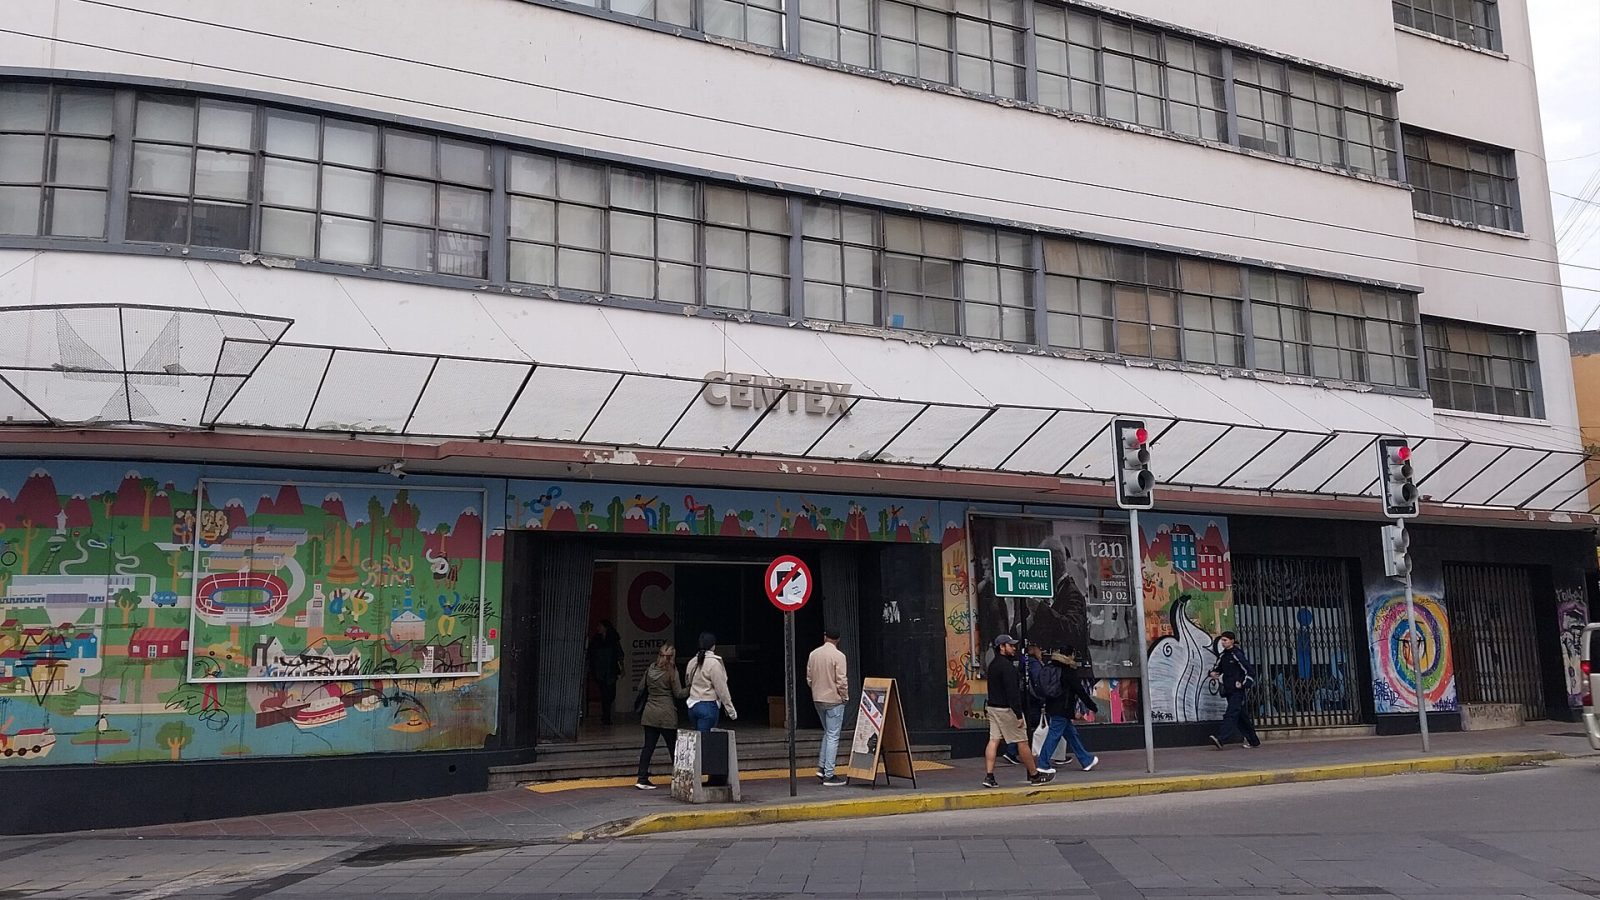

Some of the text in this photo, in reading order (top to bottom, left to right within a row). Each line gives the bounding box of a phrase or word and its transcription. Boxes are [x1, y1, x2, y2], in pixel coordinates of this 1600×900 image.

[702, 370, 853, 417] CENTEX
[1089, 539, 1125, 558] tan
[1017, 556, 1050, 566] AL ORIENTE
[1018, 569, 1048, 578] POR CALLE
[1018, 581, 1049, 591] COCHRANE
[627, 570, 673, 633] C
